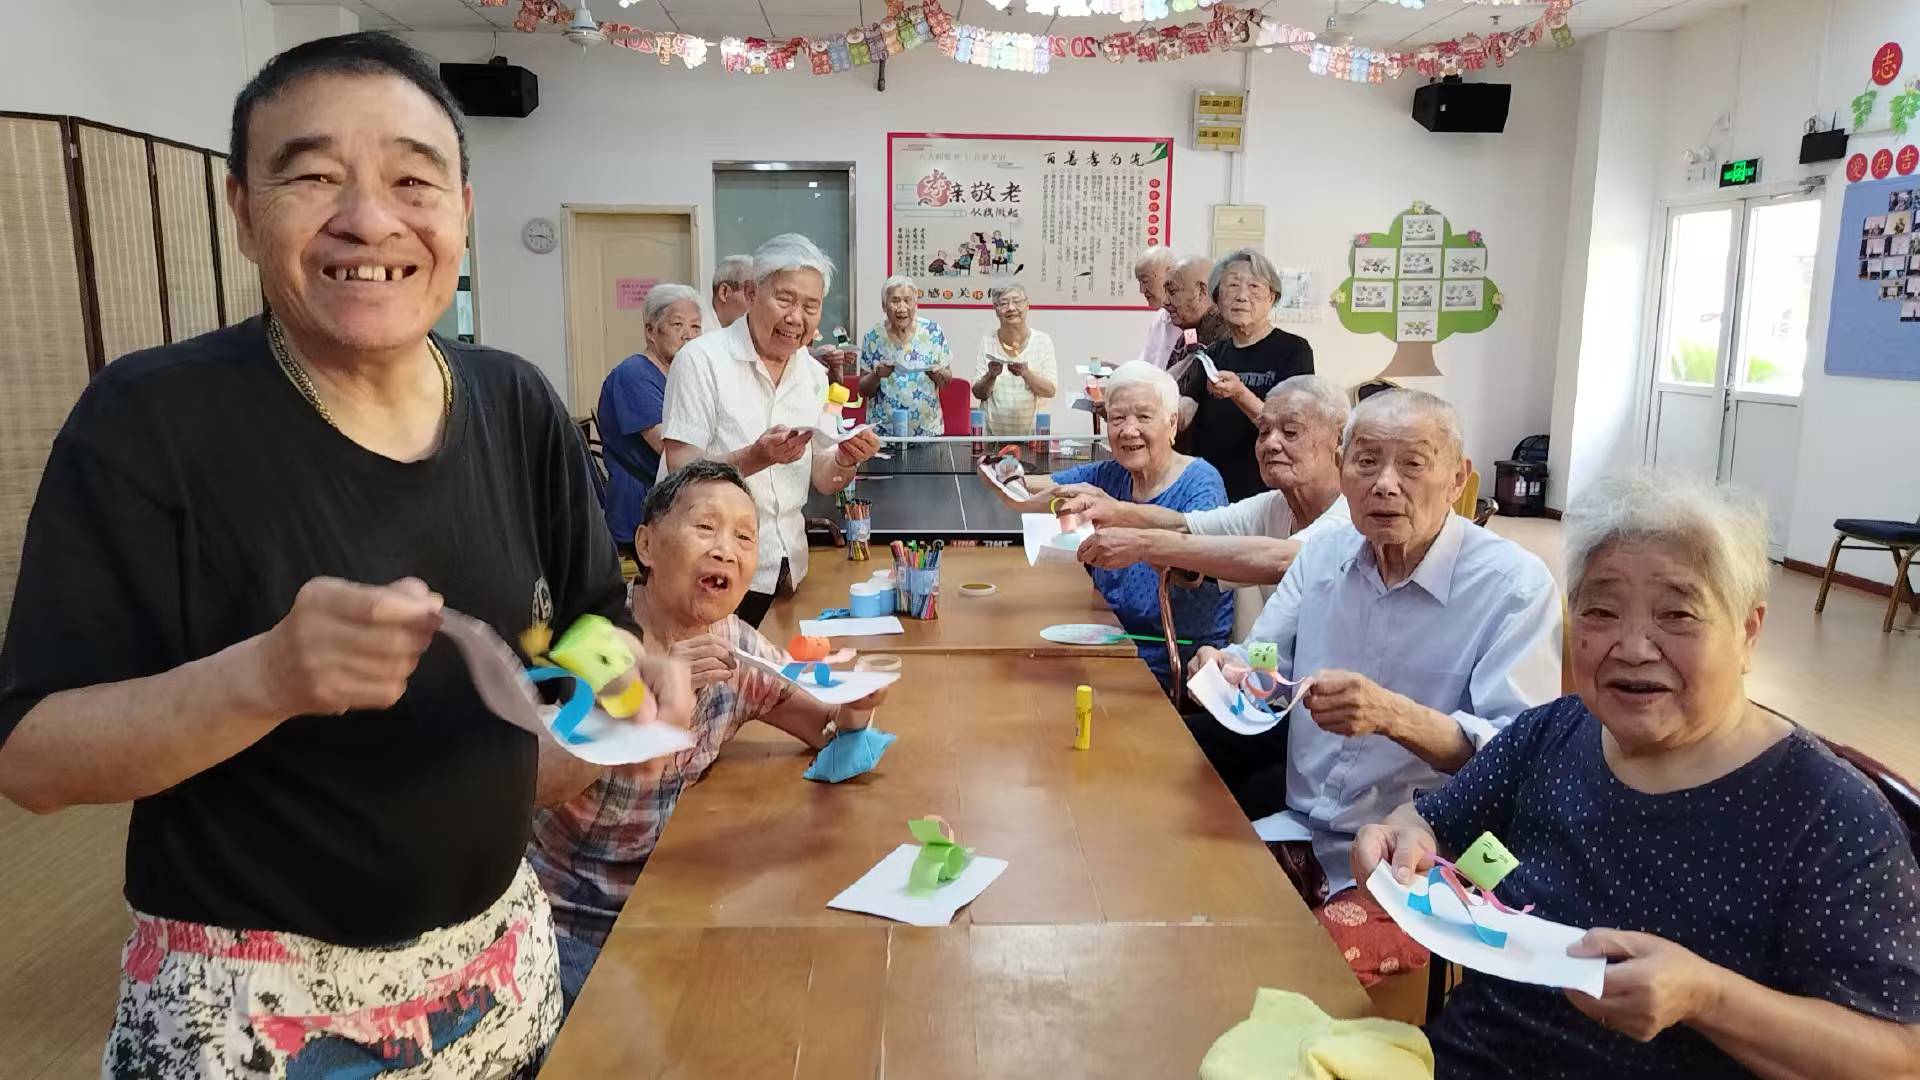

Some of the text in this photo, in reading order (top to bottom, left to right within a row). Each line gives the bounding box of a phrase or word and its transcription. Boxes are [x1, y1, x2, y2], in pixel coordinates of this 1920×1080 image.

[1875, 48, 1897, 79] 志
[1043, 149, 1145, 167] 百善孝为先
[917, 168, 1022, 207] 孝亲敬老
[970, 207, 1019, 218] 从我做起
